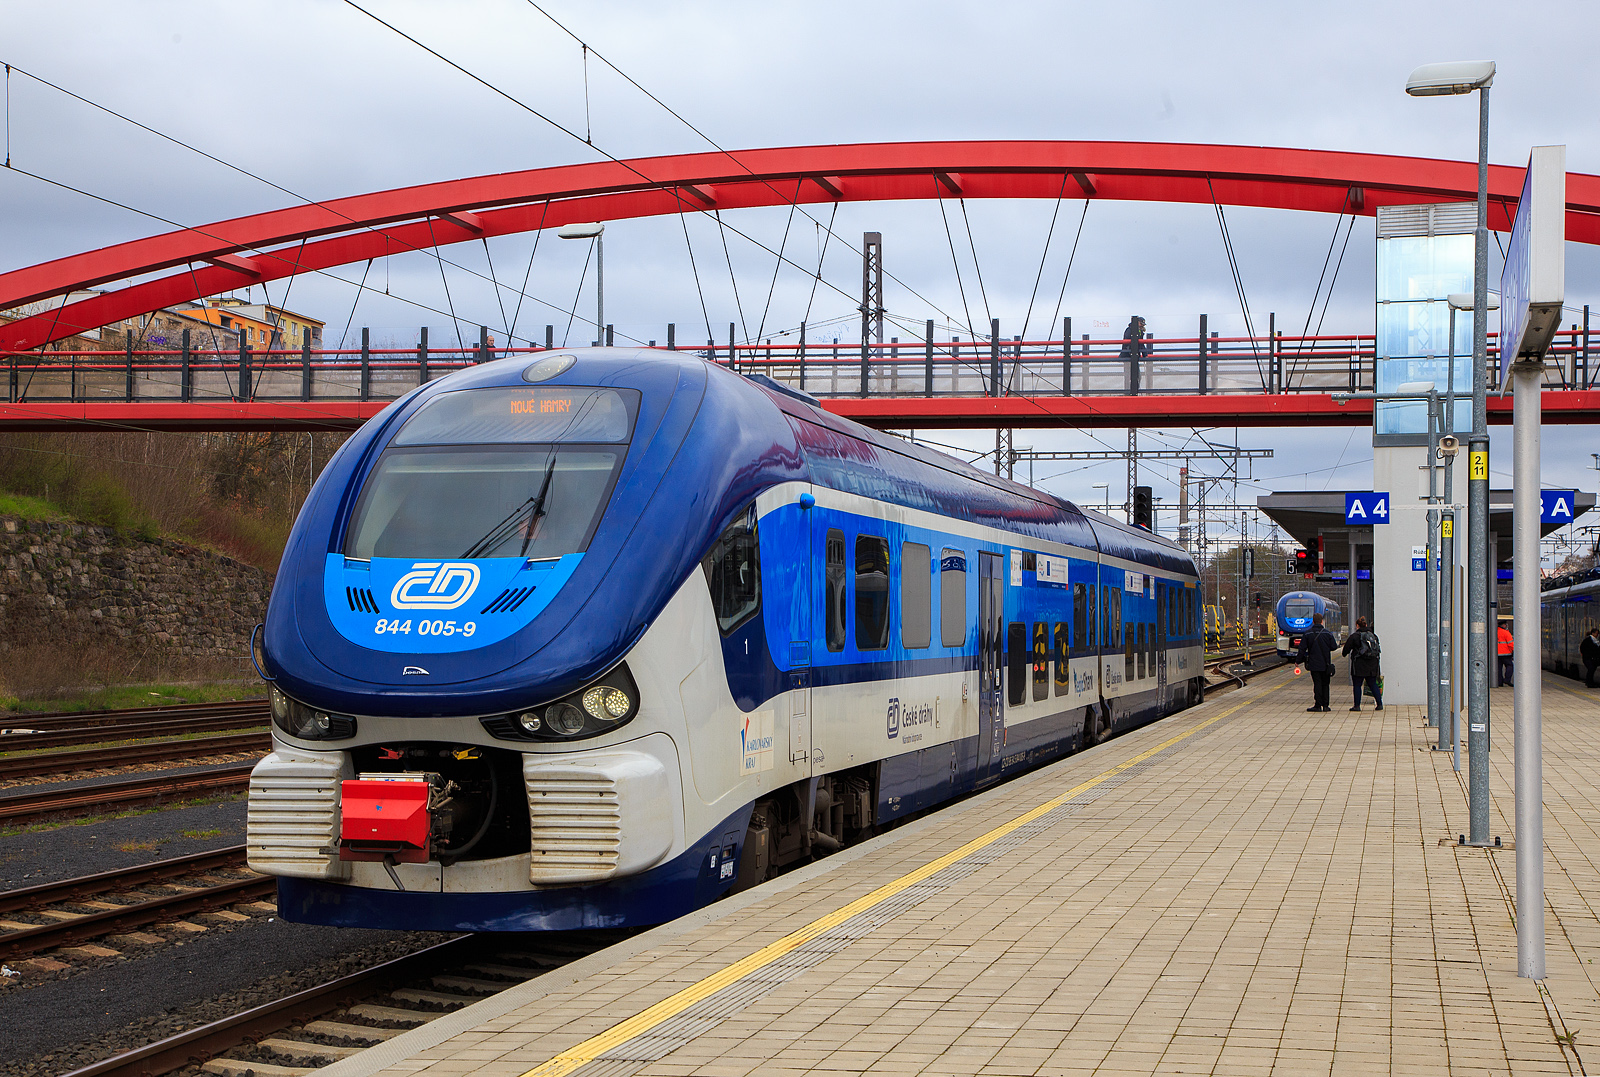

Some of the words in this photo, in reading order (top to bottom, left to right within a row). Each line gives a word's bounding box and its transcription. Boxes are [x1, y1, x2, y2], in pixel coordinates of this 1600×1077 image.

[510, 398, 535, 413] NOVÉ
[540, 399, 571, 413] HAMRY
[1474, 466, 1484, 475] 11
[1348, 499, 1367, 518] A
[1372, 498, 1387, 518] 4
[1550, 497, 1571, 517] A
[1288, 560, 1295, 574] 5
[374, 618, 412, 635] 844
[418, 619, 477, 637] 005-9
[744, 638, 749, 655] 1
[902, 703, 918, 728] České
[918, 702, 934, 727] dráhy
[995, 697, 1000, 717] 2
[745, 756, 756, 769] KRAJ
